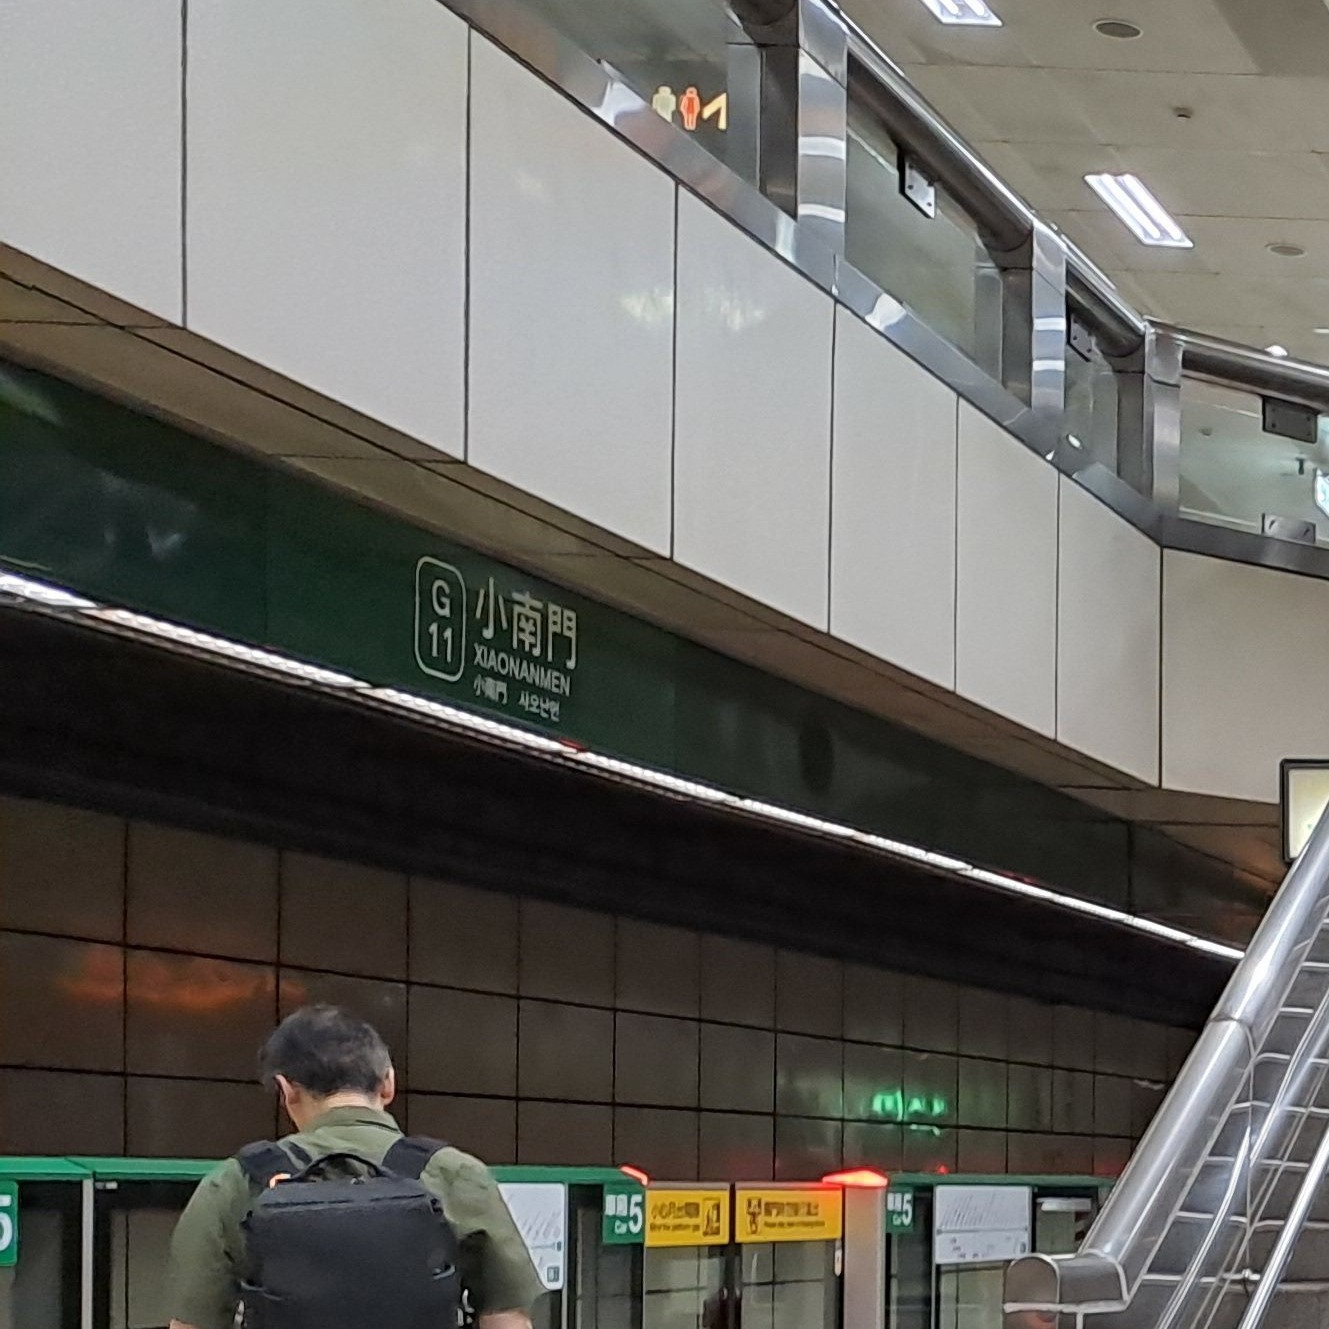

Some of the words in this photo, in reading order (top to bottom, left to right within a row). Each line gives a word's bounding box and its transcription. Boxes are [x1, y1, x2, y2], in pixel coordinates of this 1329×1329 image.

[432, 580, 450, 617] G
[429, 622, 452, 662] 11
[476, 577, 576, 669] 小南門
[474, 642, 571, 697] XIAONANMEN
[629, 1194, 643, 1234] 5
